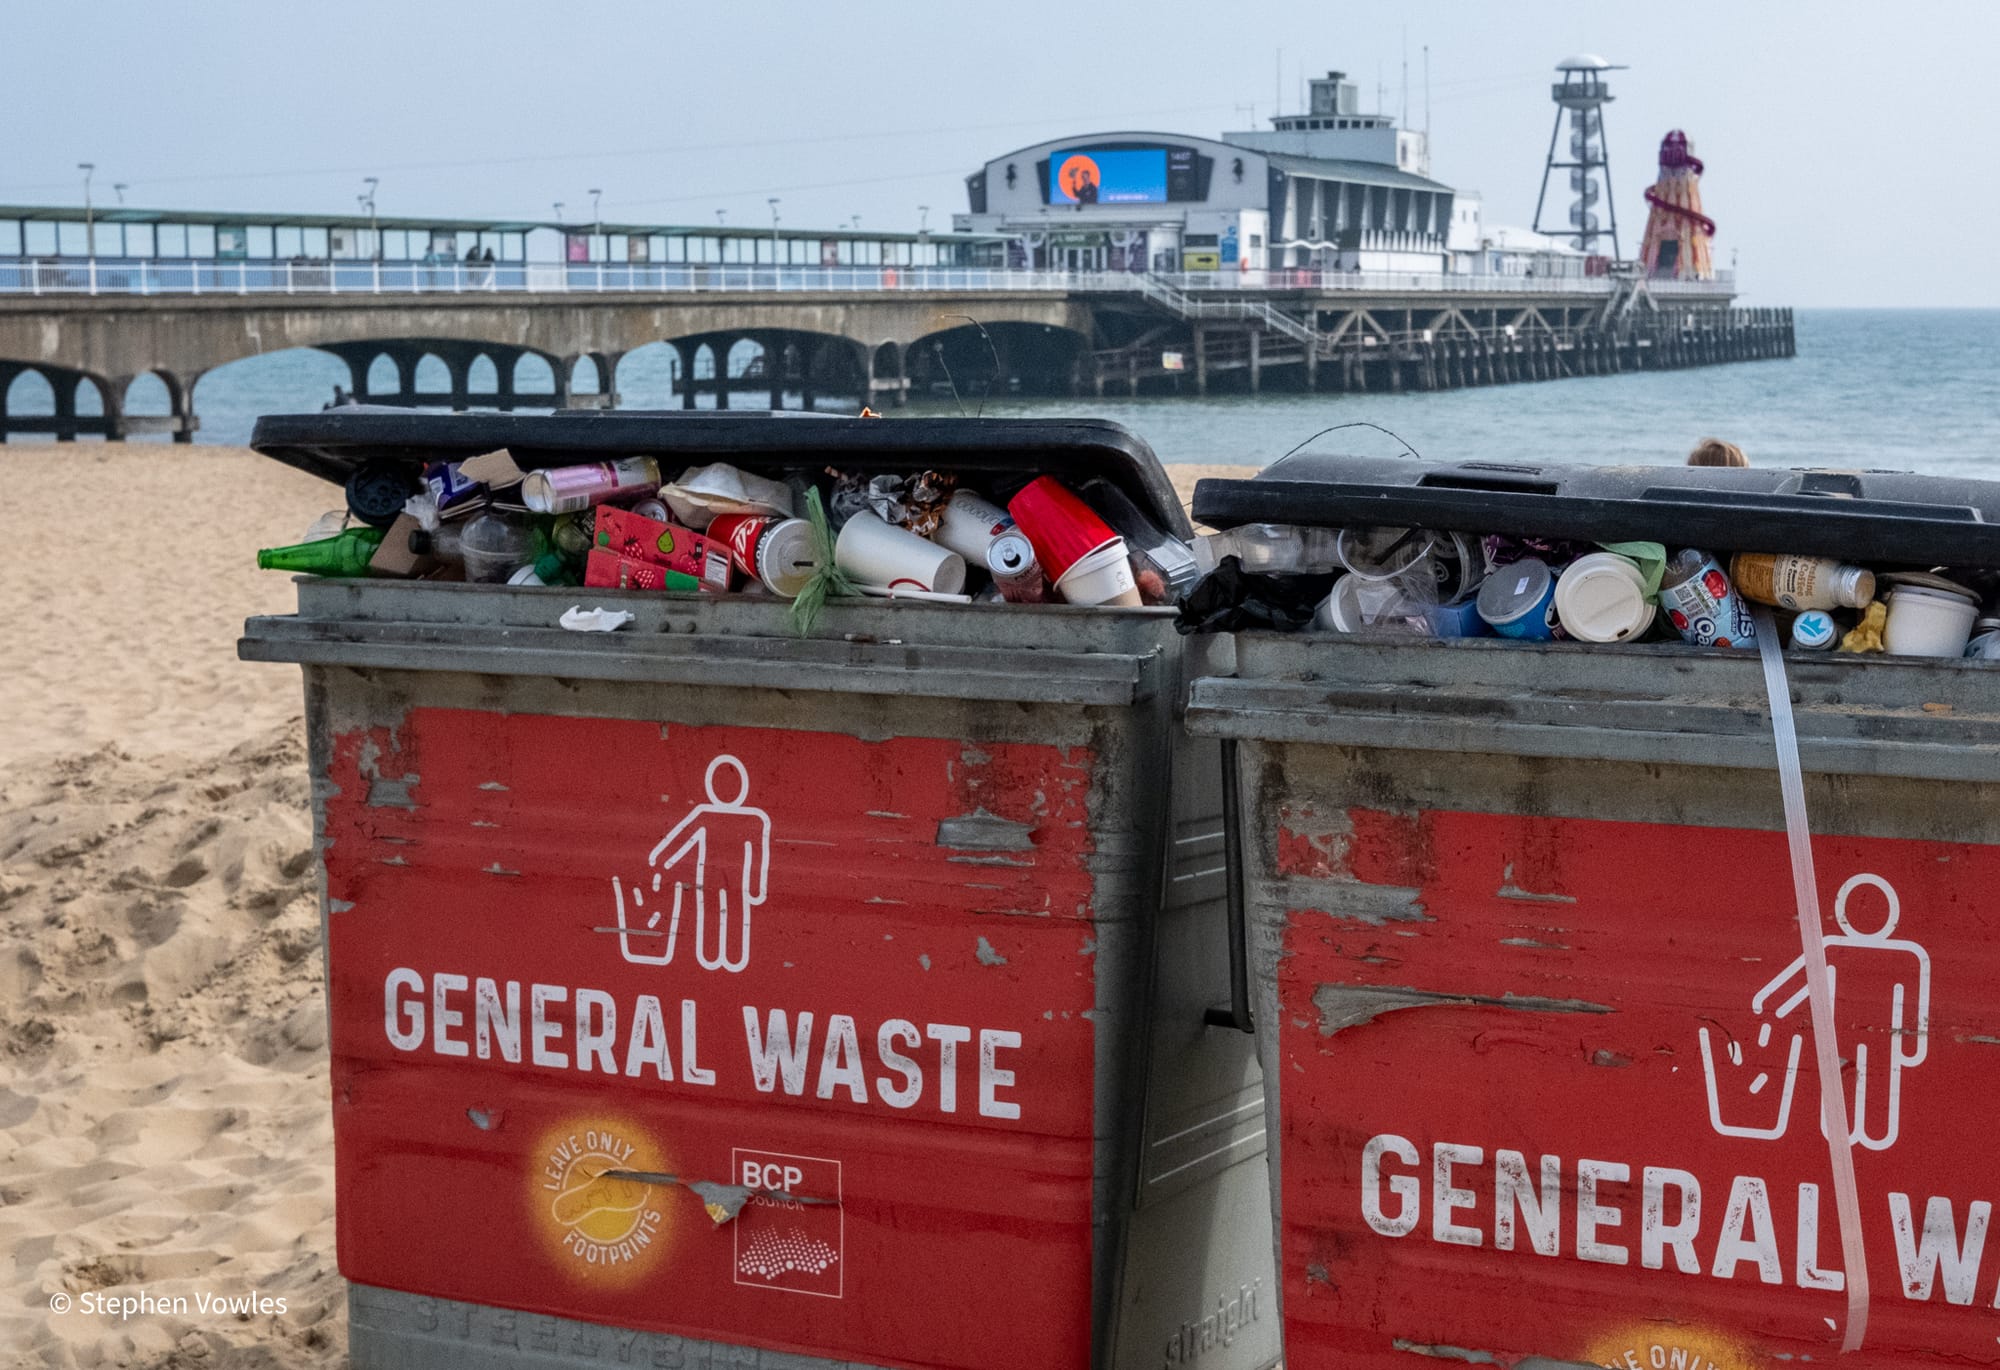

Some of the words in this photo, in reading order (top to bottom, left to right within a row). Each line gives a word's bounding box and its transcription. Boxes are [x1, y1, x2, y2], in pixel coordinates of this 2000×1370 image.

[1797, 563, 1809, 597] Coffee
[384, 967, 717, 1086] GENERAL
[742, 1006, 1022, 1120] WASTE
[543, 1135, 582, 1191] LEAVE
[586, 1131, 635, 1161] ONLY
[743, 1160, 803, 1192] BCP
[562, 1209, 662, 1265] FOOTPRINTS
[1361, 1134, 1847, 1291] GENERAL
